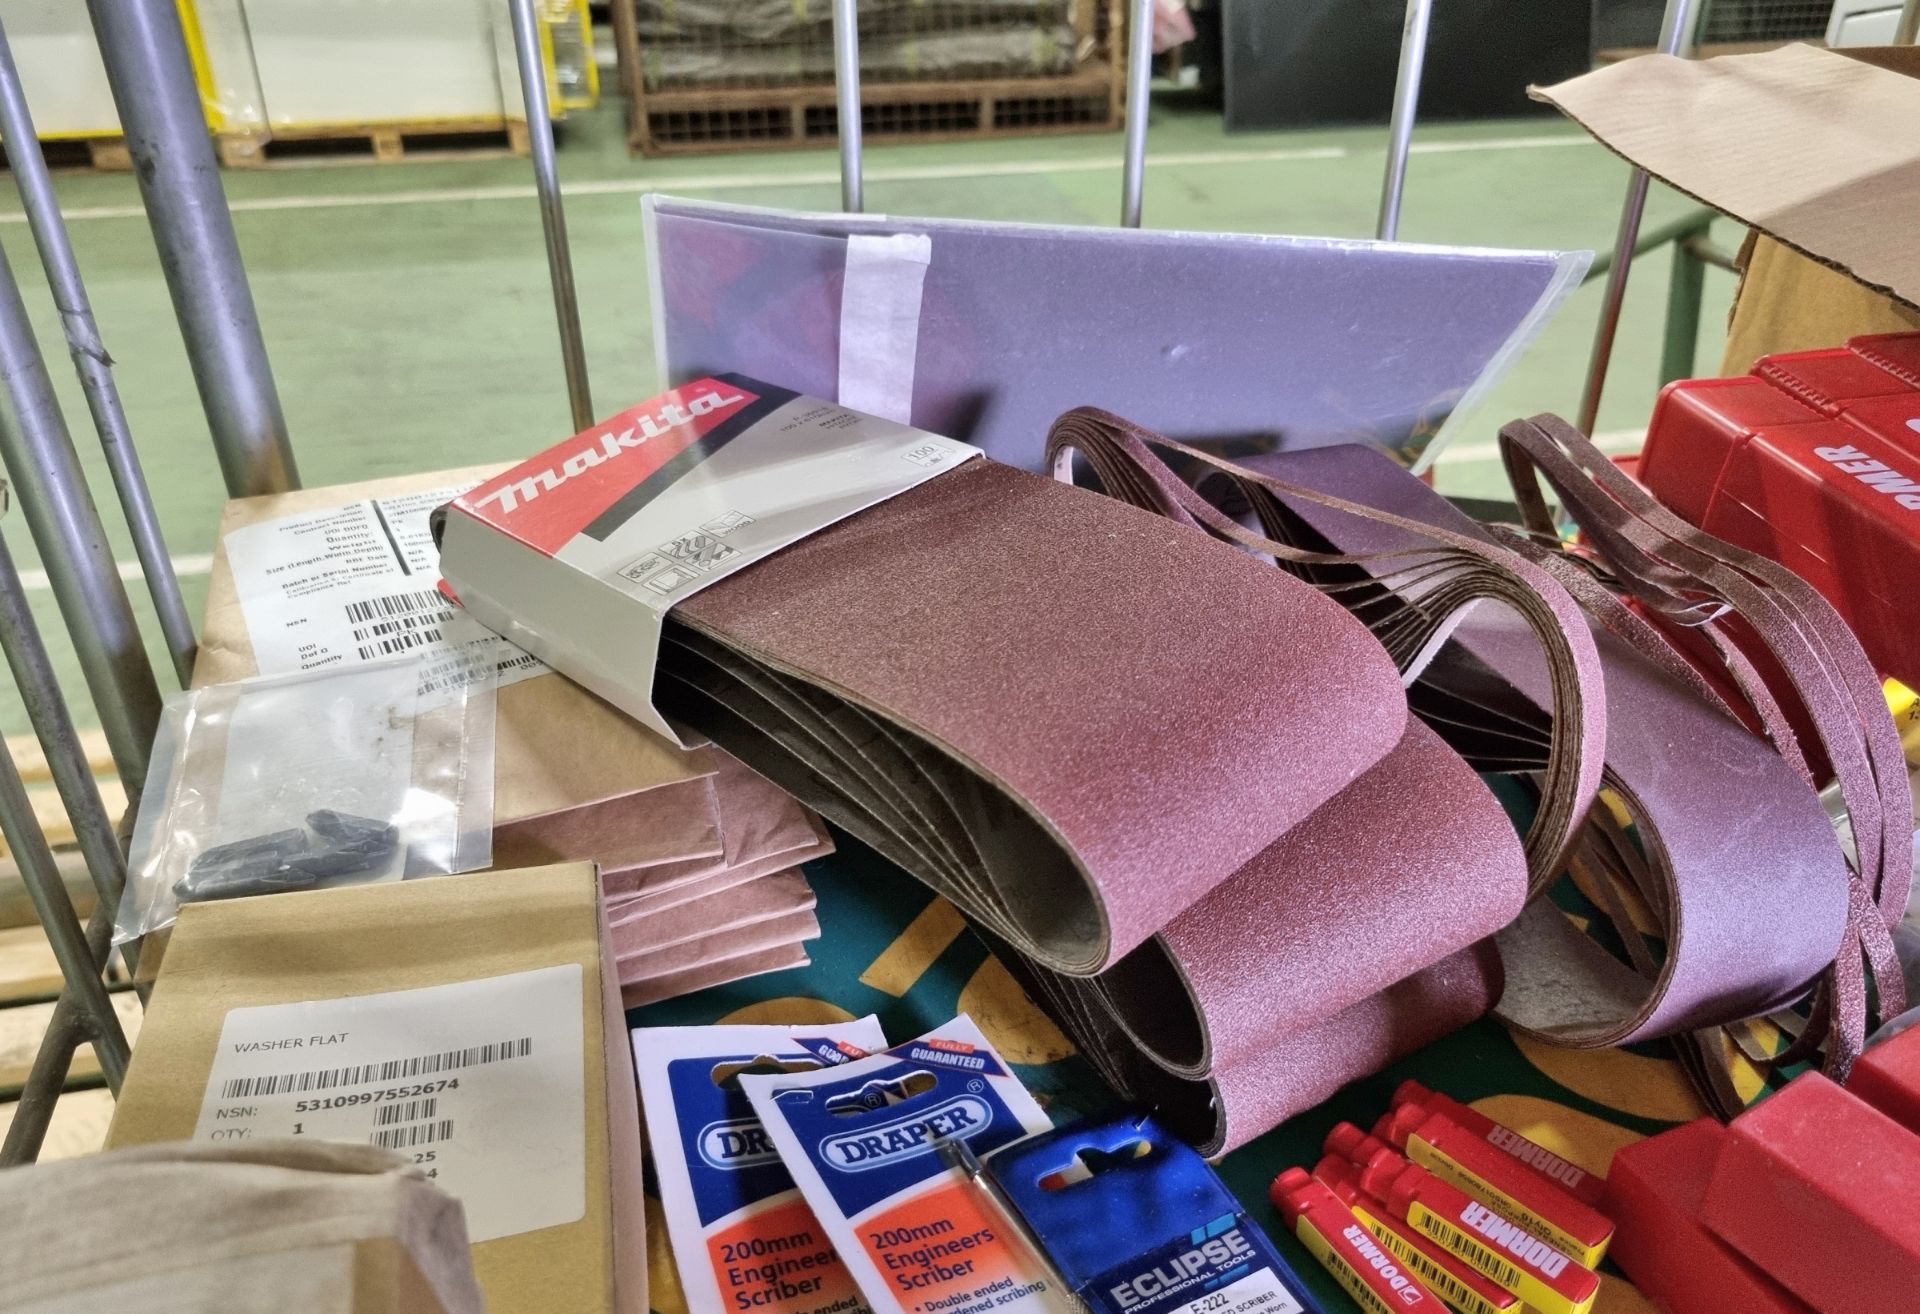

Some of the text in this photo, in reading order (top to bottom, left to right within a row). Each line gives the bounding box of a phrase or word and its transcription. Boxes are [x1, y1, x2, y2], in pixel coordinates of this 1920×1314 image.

[473, 392, 743, 514] makita
[907, 445, 934, 461] 100
[282, 579, 308, 589] Batch
[286, 618, 307, 627] NSN
[301, 654, 342, 670] Quantity
[234, 1032, 350, 1054] WASHER FLAT
[911, 1048, 986, 1070] GUARANTEED
[935, 1040, 969, 1051] FULLY
[217, 1077, 460, 1119] NSN: 5310997552674
[292, 1123, 304, 1135] 1
[834, 1106, 978, 1164] DRAPER
[1486, 1124, 1586, 1188] DORMER
[721, 1231, 814, 1263] 200mm
[869, 1218, 955, 1250] 200mm
[1460, 1200, 1570, 1280] DORMER
[882, 1229, 995, 1272] Engineers
[1343, 1224, 1411, 1299] DORMER
[896, 1259, 975, 1292] Scriber
[1110, 1229, 1251, 1308] ECLIPSE
[1124, 1250, 1256, 1314] PROFESSIONAL TOOLS
[736, 1276, 822, 1310] Scriber
[924, 1276, 1014, 1312] Double ended
[995, 1280, 1046, 1305] scribing
[1235, 1290, 1278, 1313] SCRIBER
